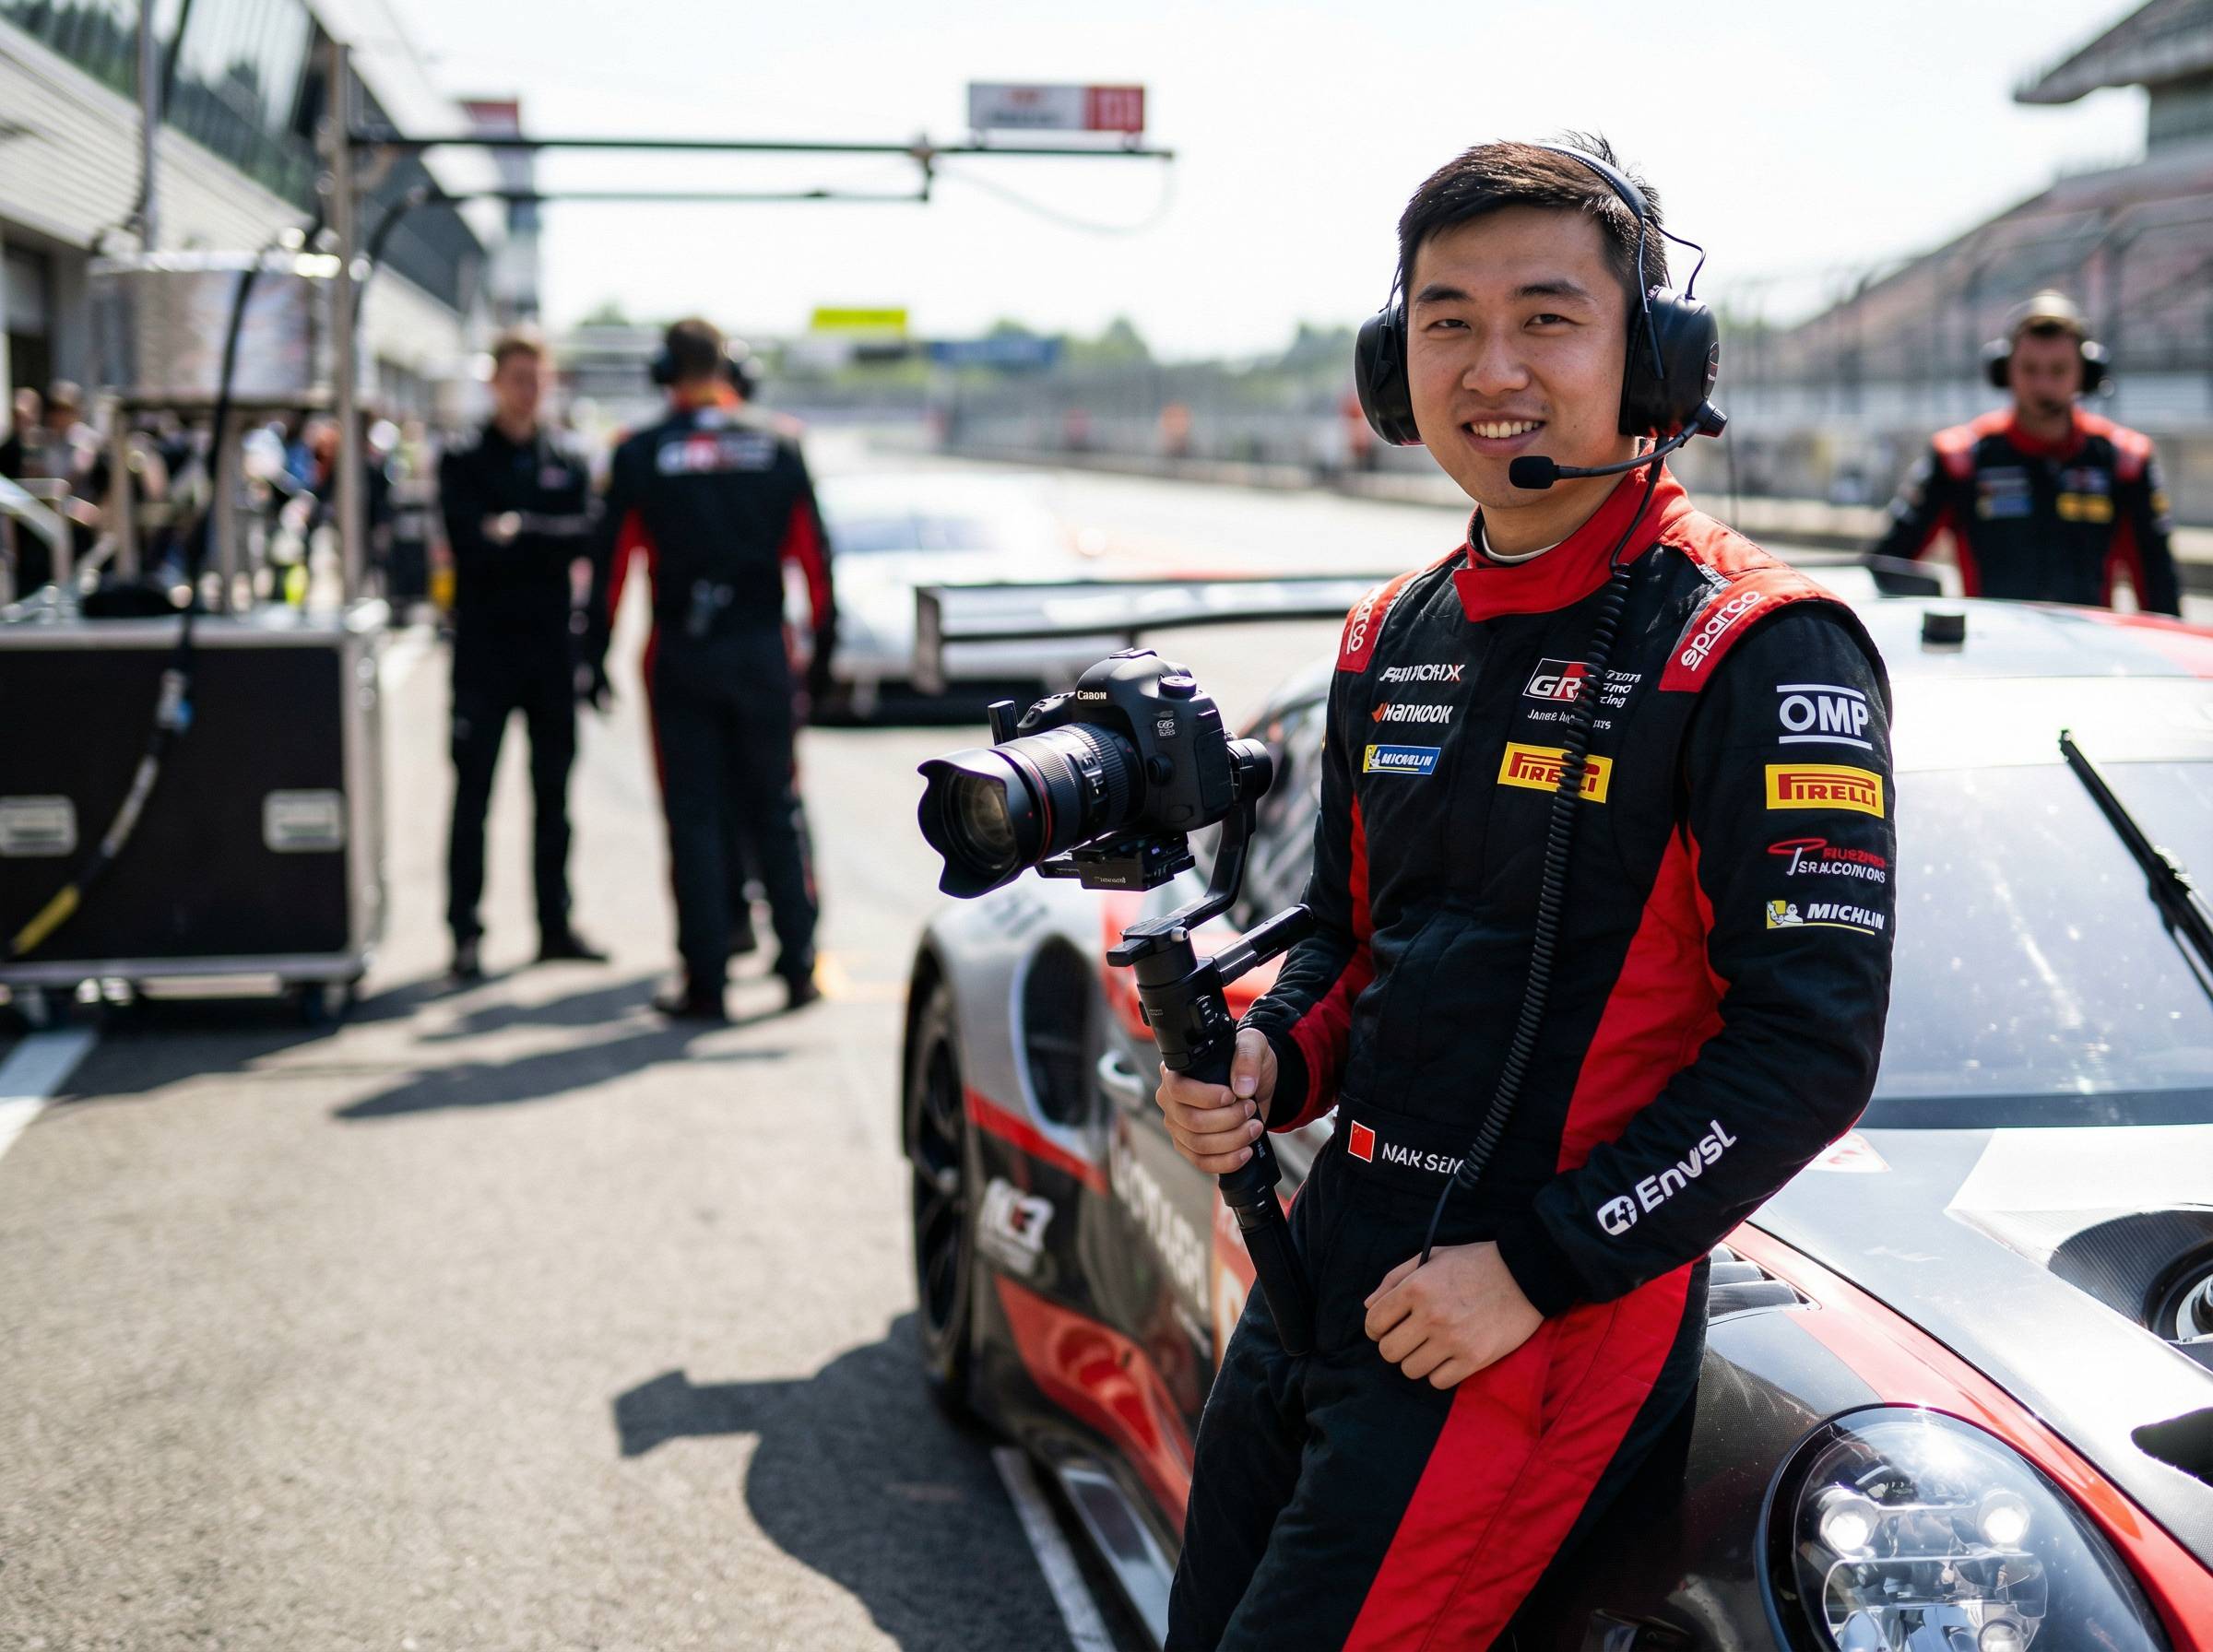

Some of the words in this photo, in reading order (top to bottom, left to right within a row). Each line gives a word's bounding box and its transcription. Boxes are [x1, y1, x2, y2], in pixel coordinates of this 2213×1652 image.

[1680, 590, 1765, 672] sparco
[1529, 675, 1582, 699] GR
[1779, 694, 1870, 738] OMP
[1507, 751, 1602, 794] PIREI
[1778, 773, 1877, 808] PIRELLI
[1806, 903, 1886, 930] MICHLIN
